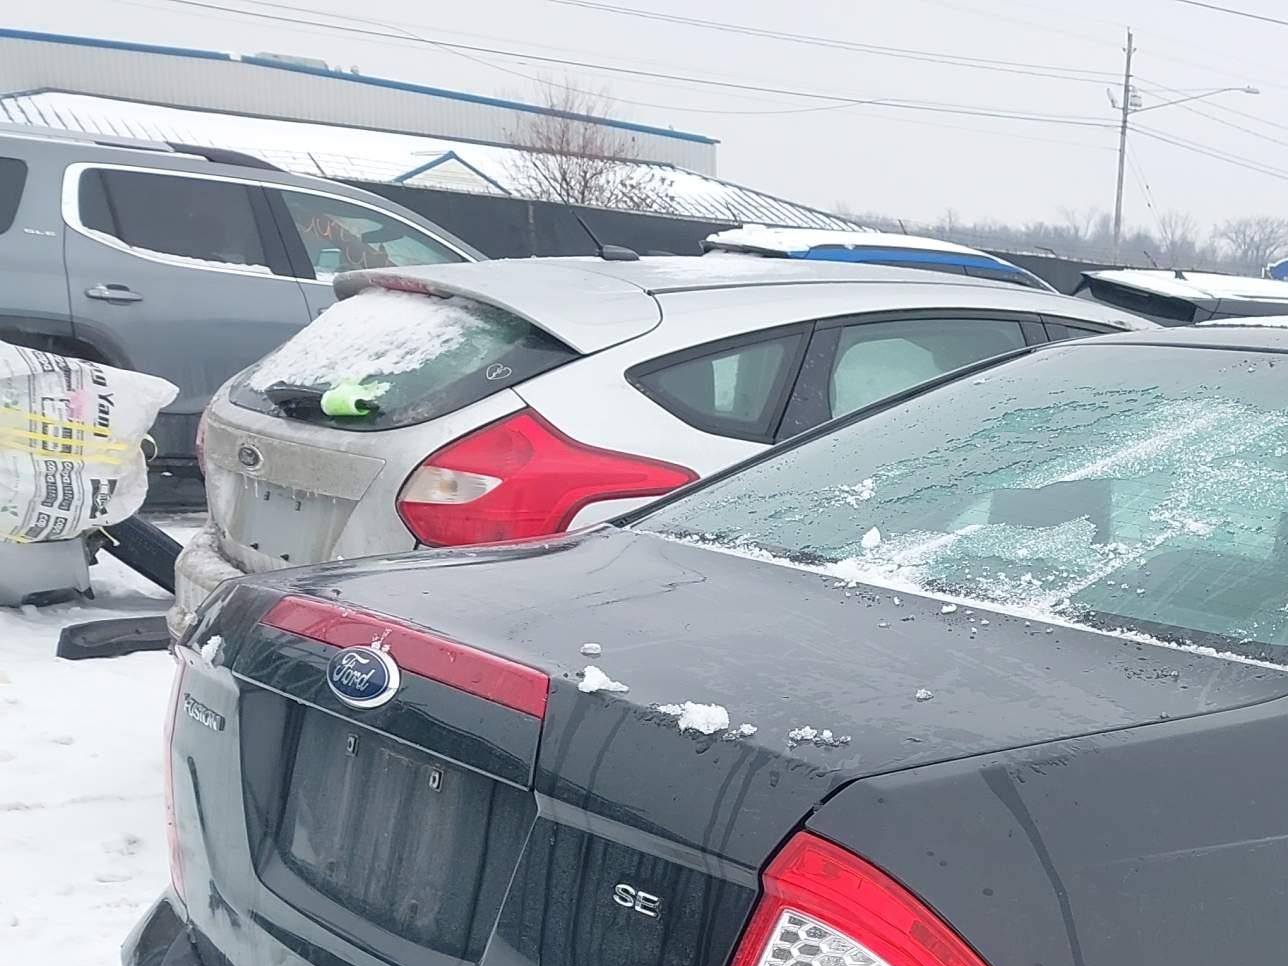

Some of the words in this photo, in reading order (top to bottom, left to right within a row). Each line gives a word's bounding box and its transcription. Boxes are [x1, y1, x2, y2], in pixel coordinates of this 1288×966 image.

[332, 652, 376, 691] Ford
[184, 693, 226, 731] FUSION
[613, 884, 661, 918] SE
